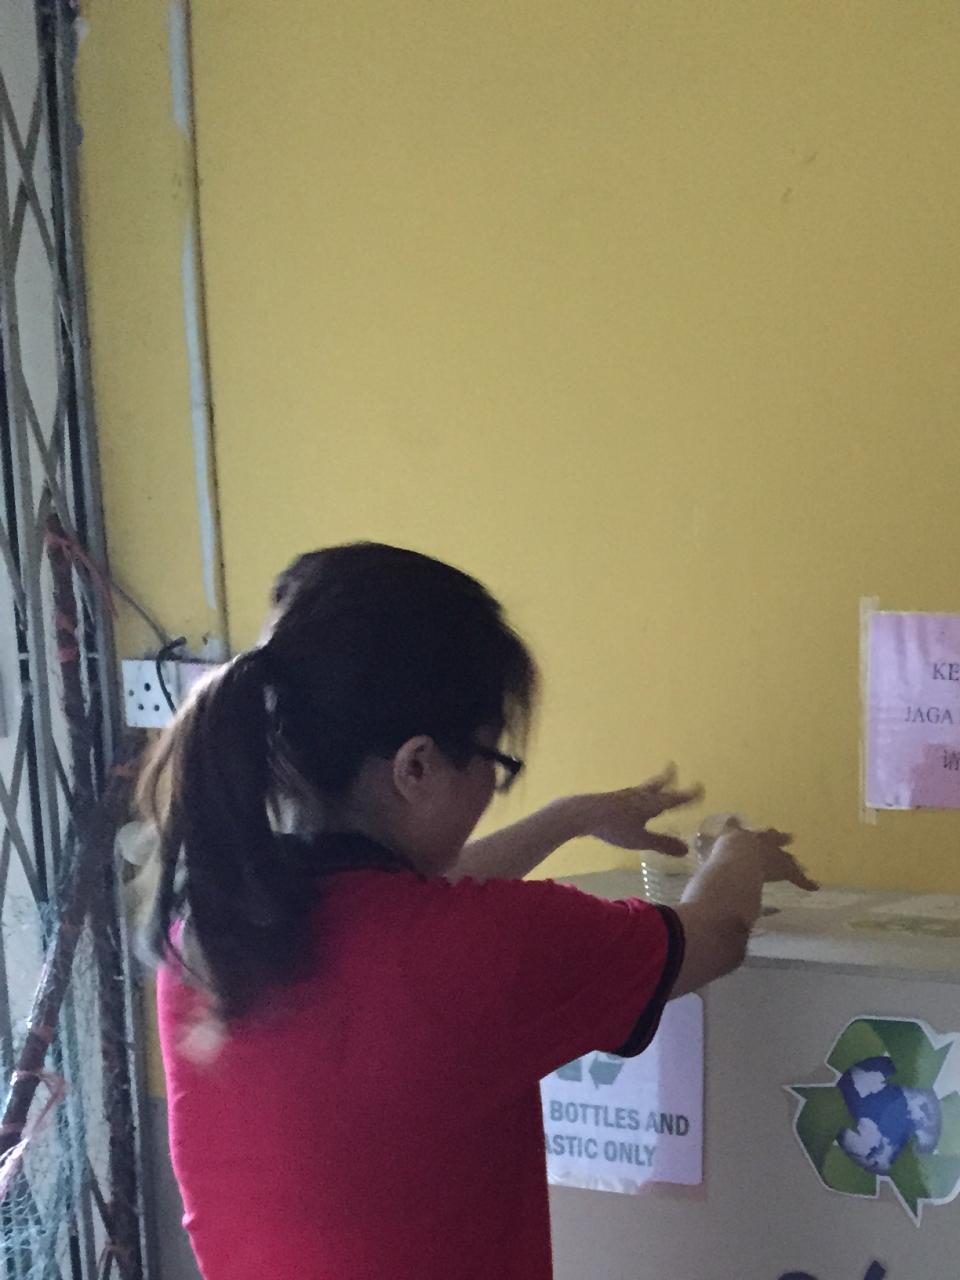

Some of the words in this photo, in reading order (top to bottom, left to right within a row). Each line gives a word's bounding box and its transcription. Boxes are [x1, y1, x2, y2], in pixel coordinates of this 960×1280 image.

[904, 706, 954, 725] JAGA
[550, 1099, 641, 1132] BOTTLES
[645, 1111, 690, 1138] AND
[546, 1132, 599, 1160] STIC
[603, 1140, 657, 1169] ONLY
